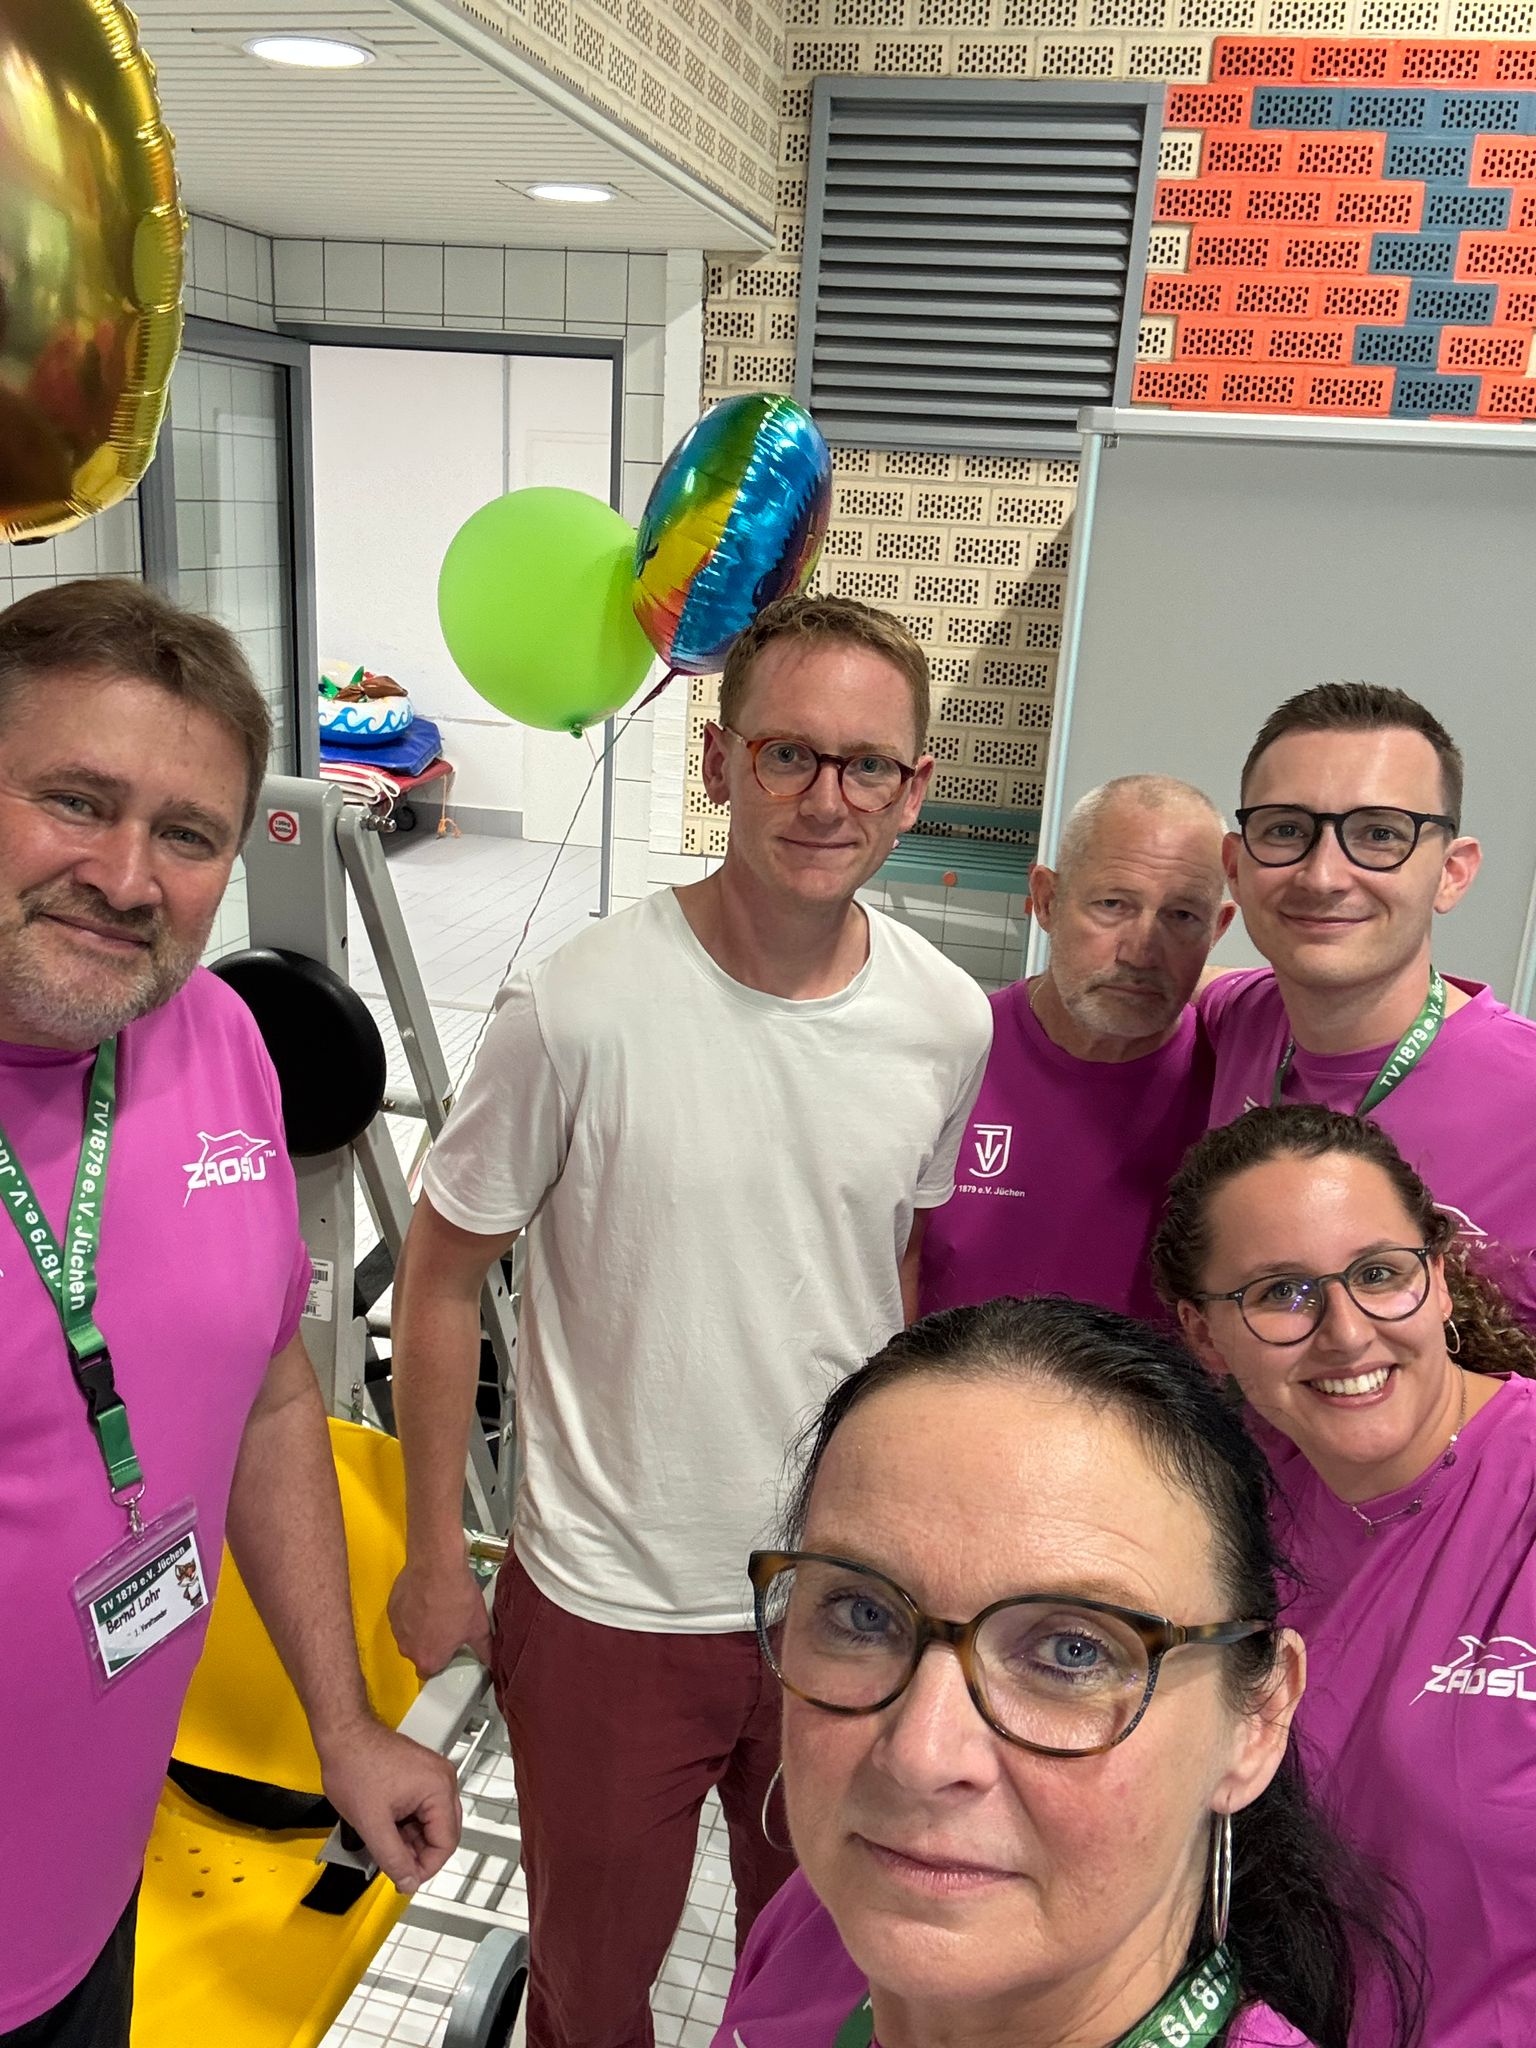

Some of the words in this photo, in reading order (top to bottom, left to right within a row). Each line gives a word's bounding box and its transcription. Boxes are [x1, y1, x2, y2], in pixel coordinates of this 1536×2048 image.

[1379, 1064, 1402, 1087] TV
[1395, 1028, 1429, 1067] 1879
[94, 1101, 108, 1127] TV
[85, 1128, 107, 1176] 1879
[182, 1156, 266, 1190] ZAOSU
[76, 1180, 96, 1221] e.V.
[959, 1184, 977, 1194] 1879
[994, 1186, 1025, 1197] Jüchen
[30, 1228, 62, 1280] 1879
[68, 1225, 93, 1311] Jüchen
[101, 1598, 114, 1614] TV
[116, 1581, 138, 1603] 1879
[140, 1568, 156, 1587] e.V.
[157, 1546, 185, 1573] Jüchen
[106, 1602, 136, 1634] Bernd
[138, 1588, 160, 1612] Lohr
[1160, 1966, 1228, 2048] 1879
